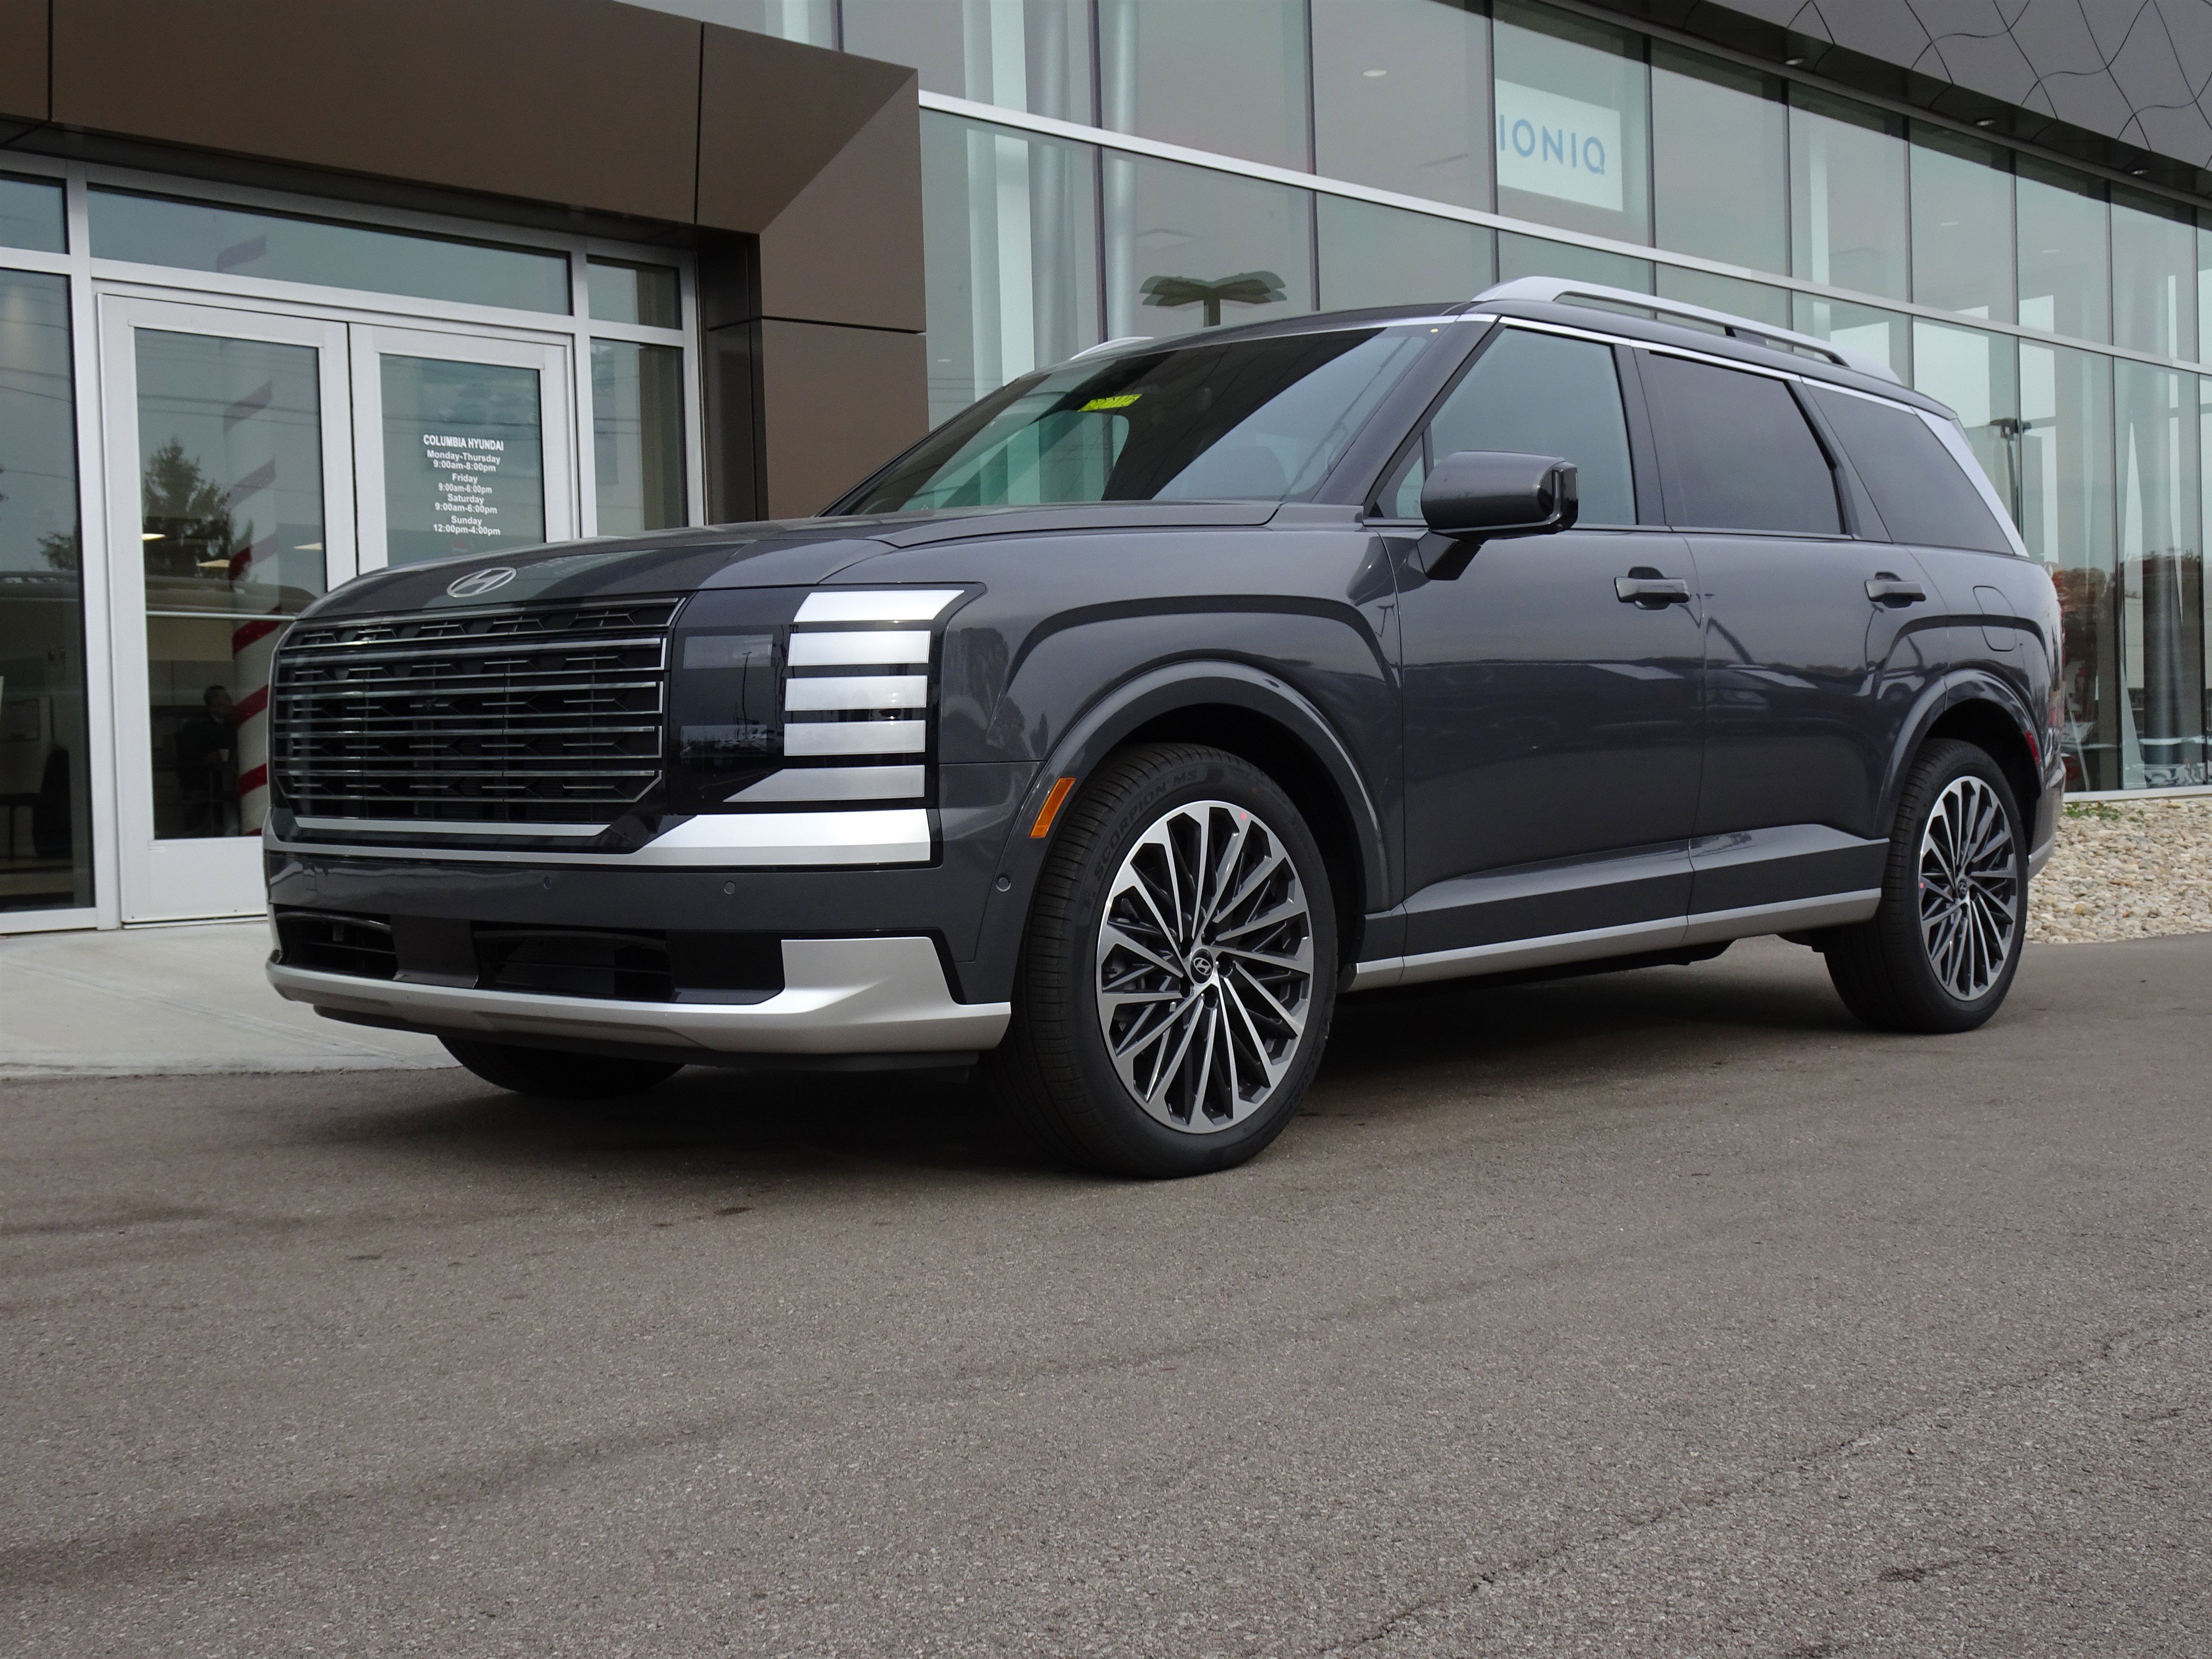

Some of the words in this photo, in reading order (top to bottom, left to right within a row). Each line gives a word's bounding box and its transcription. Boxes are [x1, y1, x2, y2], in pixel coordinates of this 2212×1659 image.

[1499, 114, 1606, 176] IONIQ
[423, 434, 467, 448] COLUMBIA
[468, 438, 504, 451] HYUNDAI
[427, 449, 501, 465] Monday-Thursday
[433, 460, 496, 473] 9:00am-8:00pm
[452, 473, 478, 484] Friday
[448, 493, 484, 505] Saturday
[451, 516, 482, 527] Sunday
[434, 524, 501, 536] 12:00pm-4:00pm
[1094, 780, 1166, 879] SCORPION
